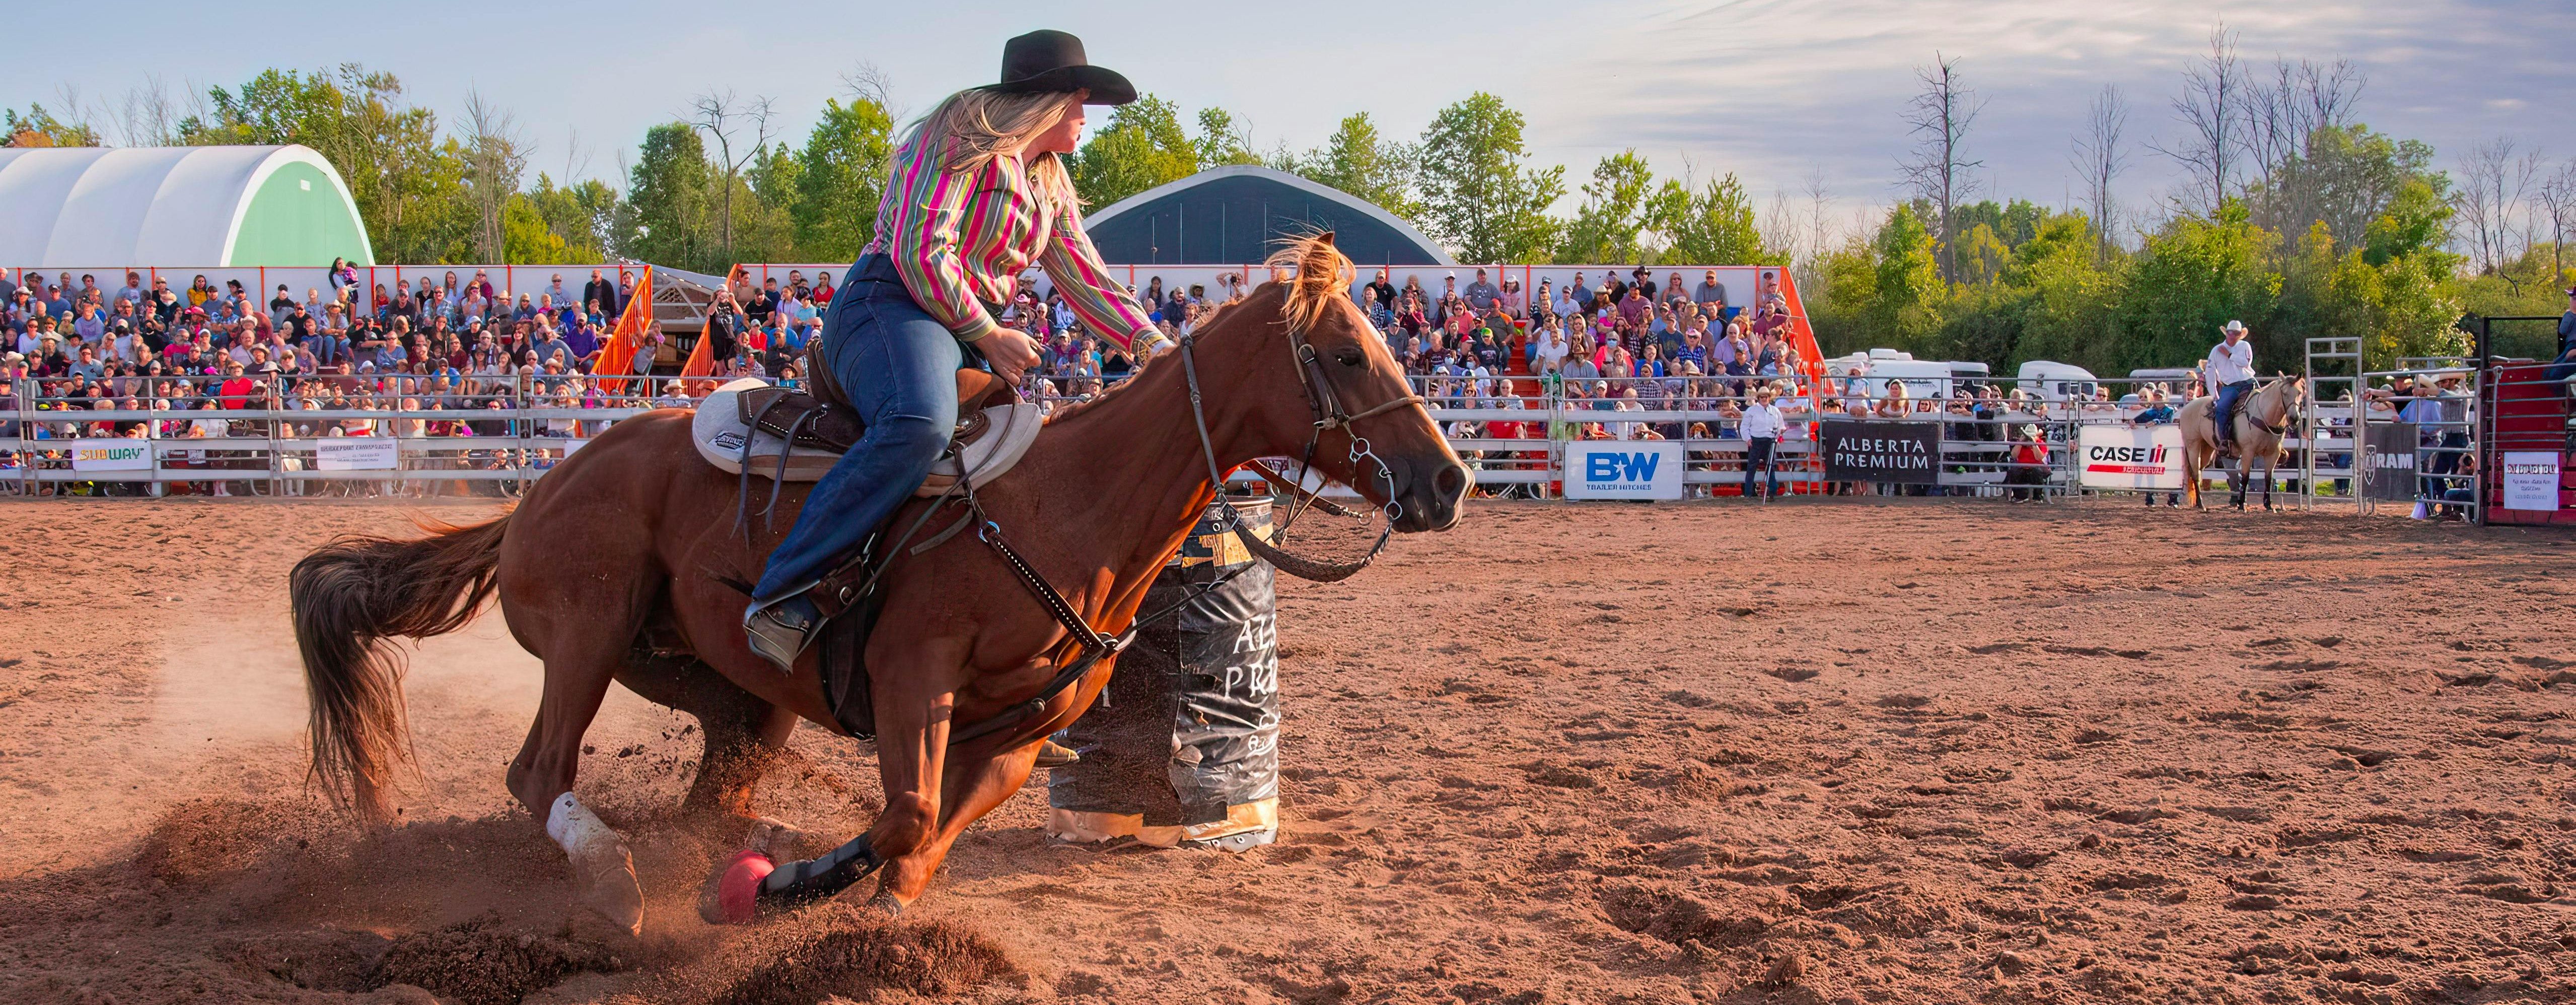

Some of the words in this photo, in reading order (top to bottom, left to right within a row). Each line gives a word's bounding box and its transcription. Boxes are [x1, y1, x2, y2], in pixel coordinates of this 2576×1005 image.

[1837, 437, 1925, 453] ALBERTA
[80, 448, 140, 461] SUBWAY
[1835, 453, 1928, 469] PREMIUM
[2090, 446, 2145, 462] CASE
[2376, 453, 2413, 469] RAM
